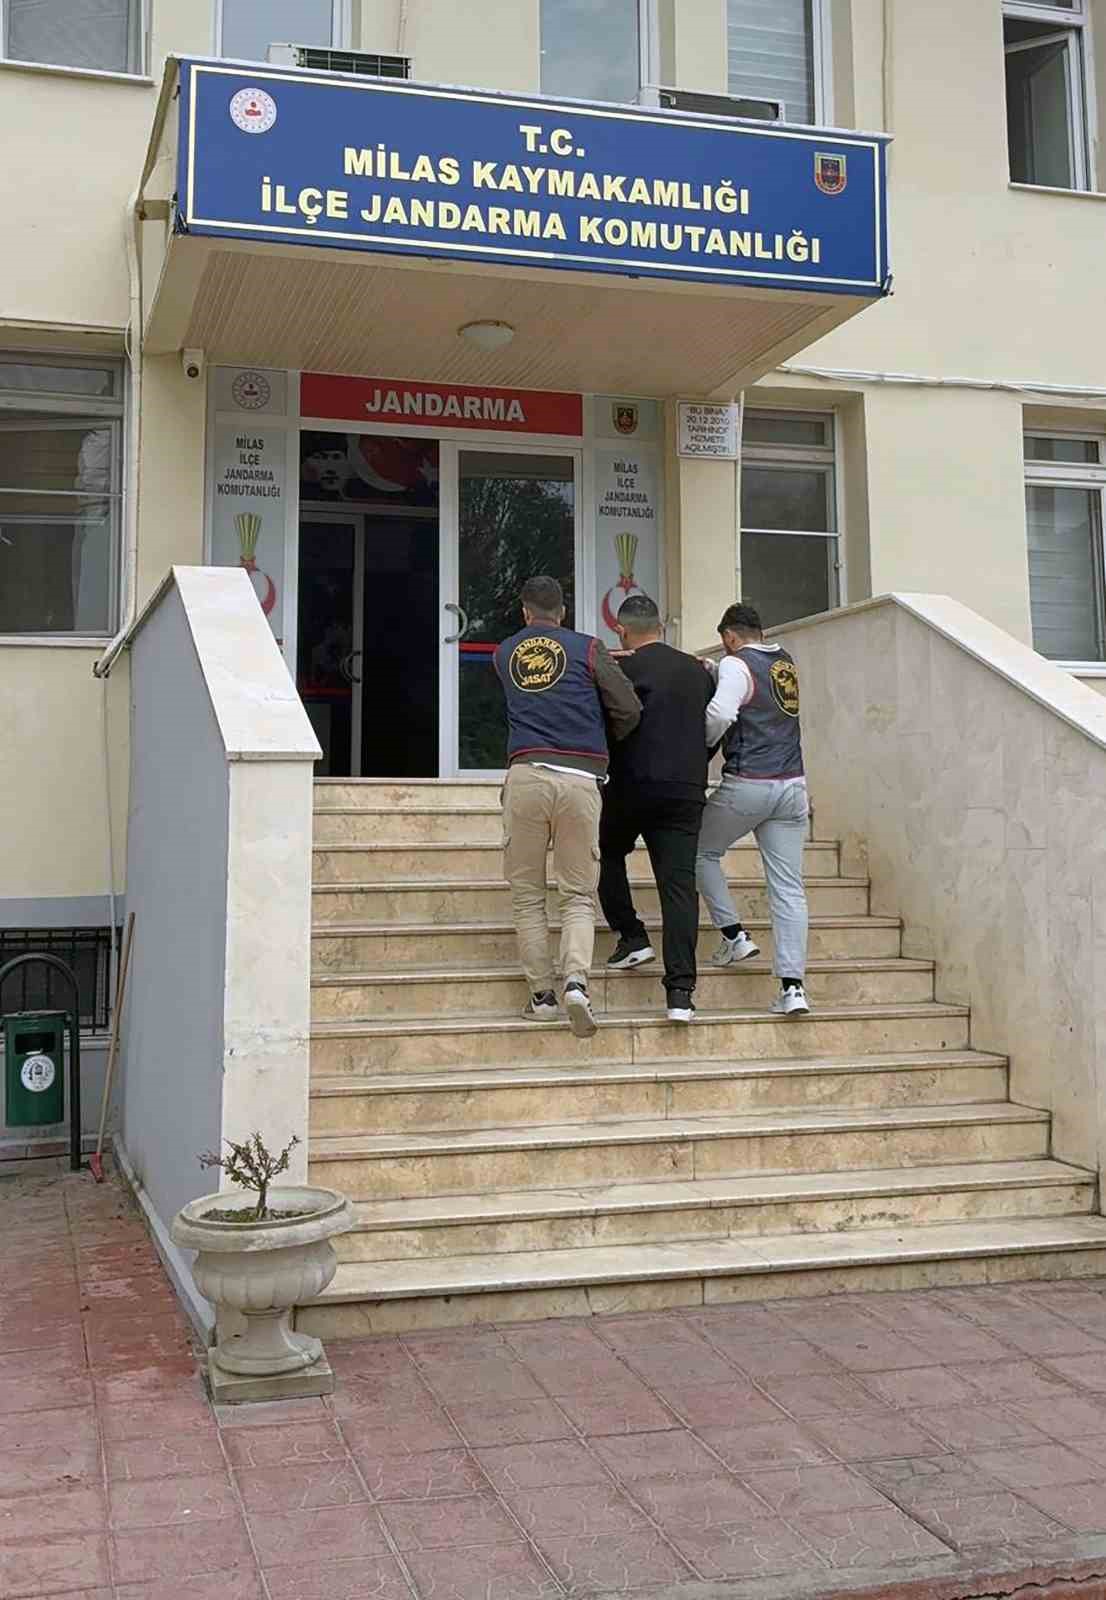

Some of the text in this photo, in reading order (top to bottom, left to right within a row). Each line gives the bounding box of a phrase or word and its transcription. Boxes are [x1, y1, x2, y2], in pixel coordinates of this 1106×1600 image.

[519, 124, 585, 157] T.C.
[344, 143, 750, 216] MİLAS KAYMAKAMLIĞI
[261, 176, 821, 264] İLÇE JANDARMA KOMUTANLIĞI
[365, 389, 526, 422] JANDARMA
[235, 433, 264, 450] MİLAS
[613, 458, 638, 474] MİLAS
[224, 468, 274, 481] JANDARMA
[217, 482, 281, 498] KOMUTANLIĞI
[604, 491, 648, 503] JANDARMA
[599, 504, 654, 519] KOMUTANLIĞI
[515, 637, 561, 657] JANDARMA
[520, 673, 552, 687] JASAT
